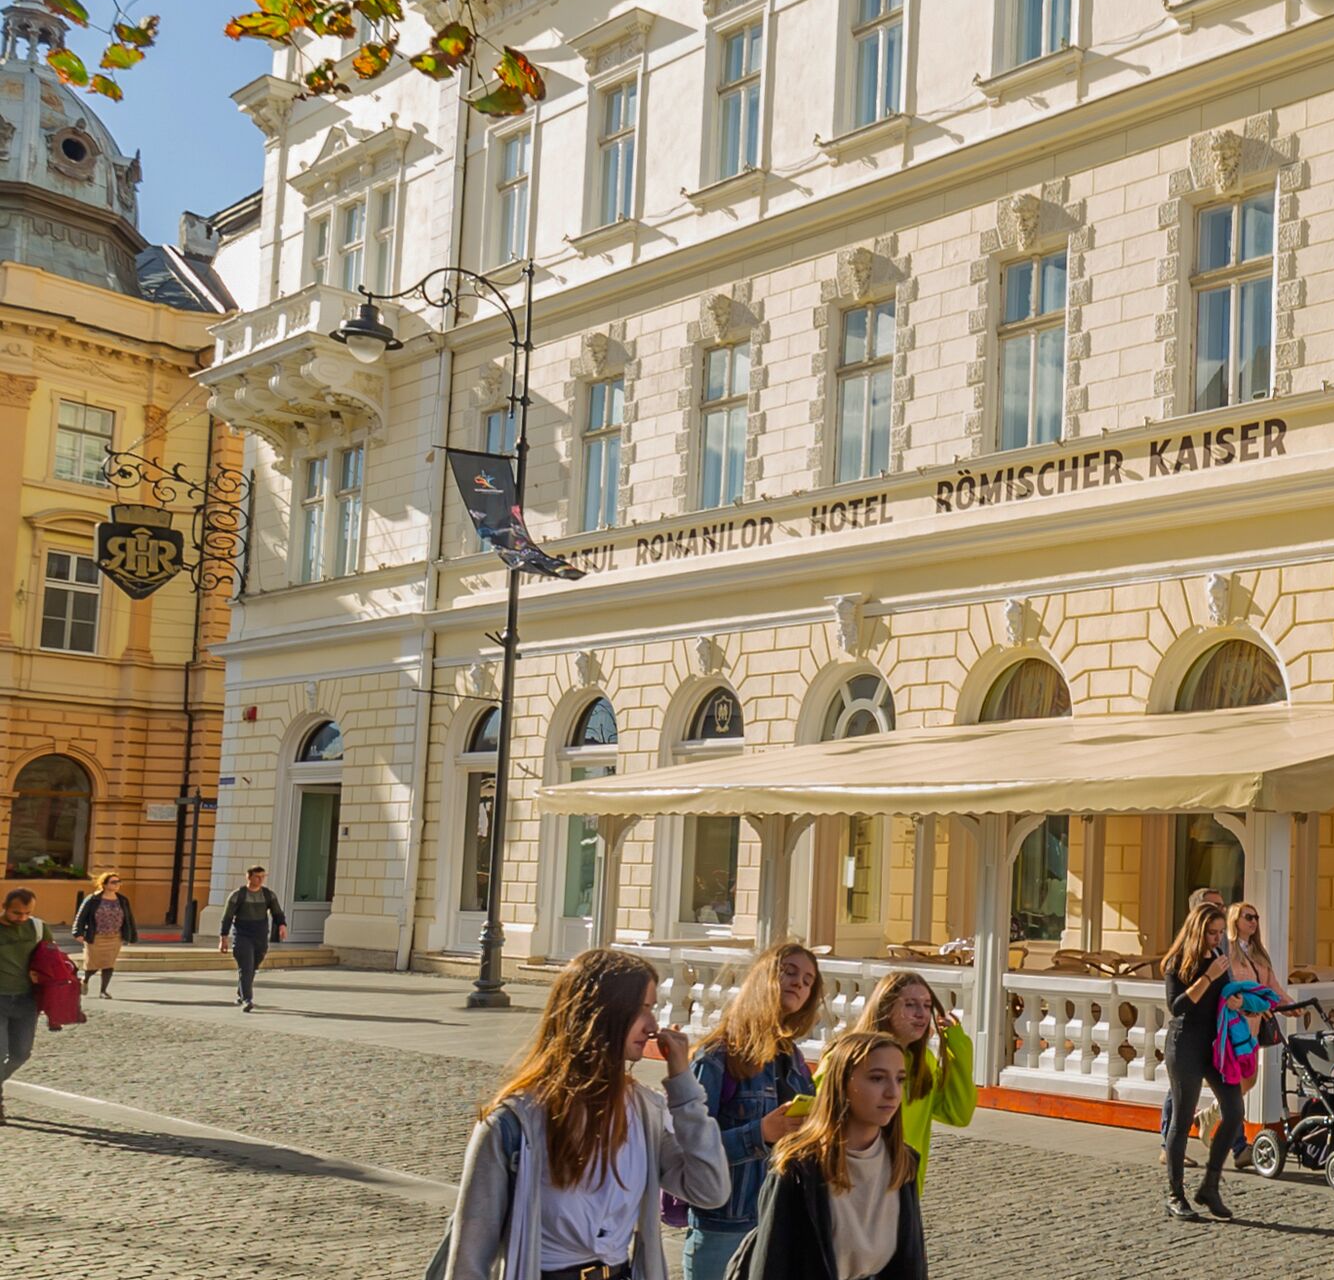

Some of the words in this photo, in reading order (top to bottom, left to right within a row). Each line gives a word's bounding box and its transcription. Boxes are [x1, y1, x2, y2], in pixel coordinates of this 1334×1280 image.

[636, 516, 774, 567] ROMANILOR
[811, 494, 894, 536] HOTEL
[935, 449, 1124, 514] RÖMISCHER
[1148, 418, 1289, 477] KAISER
